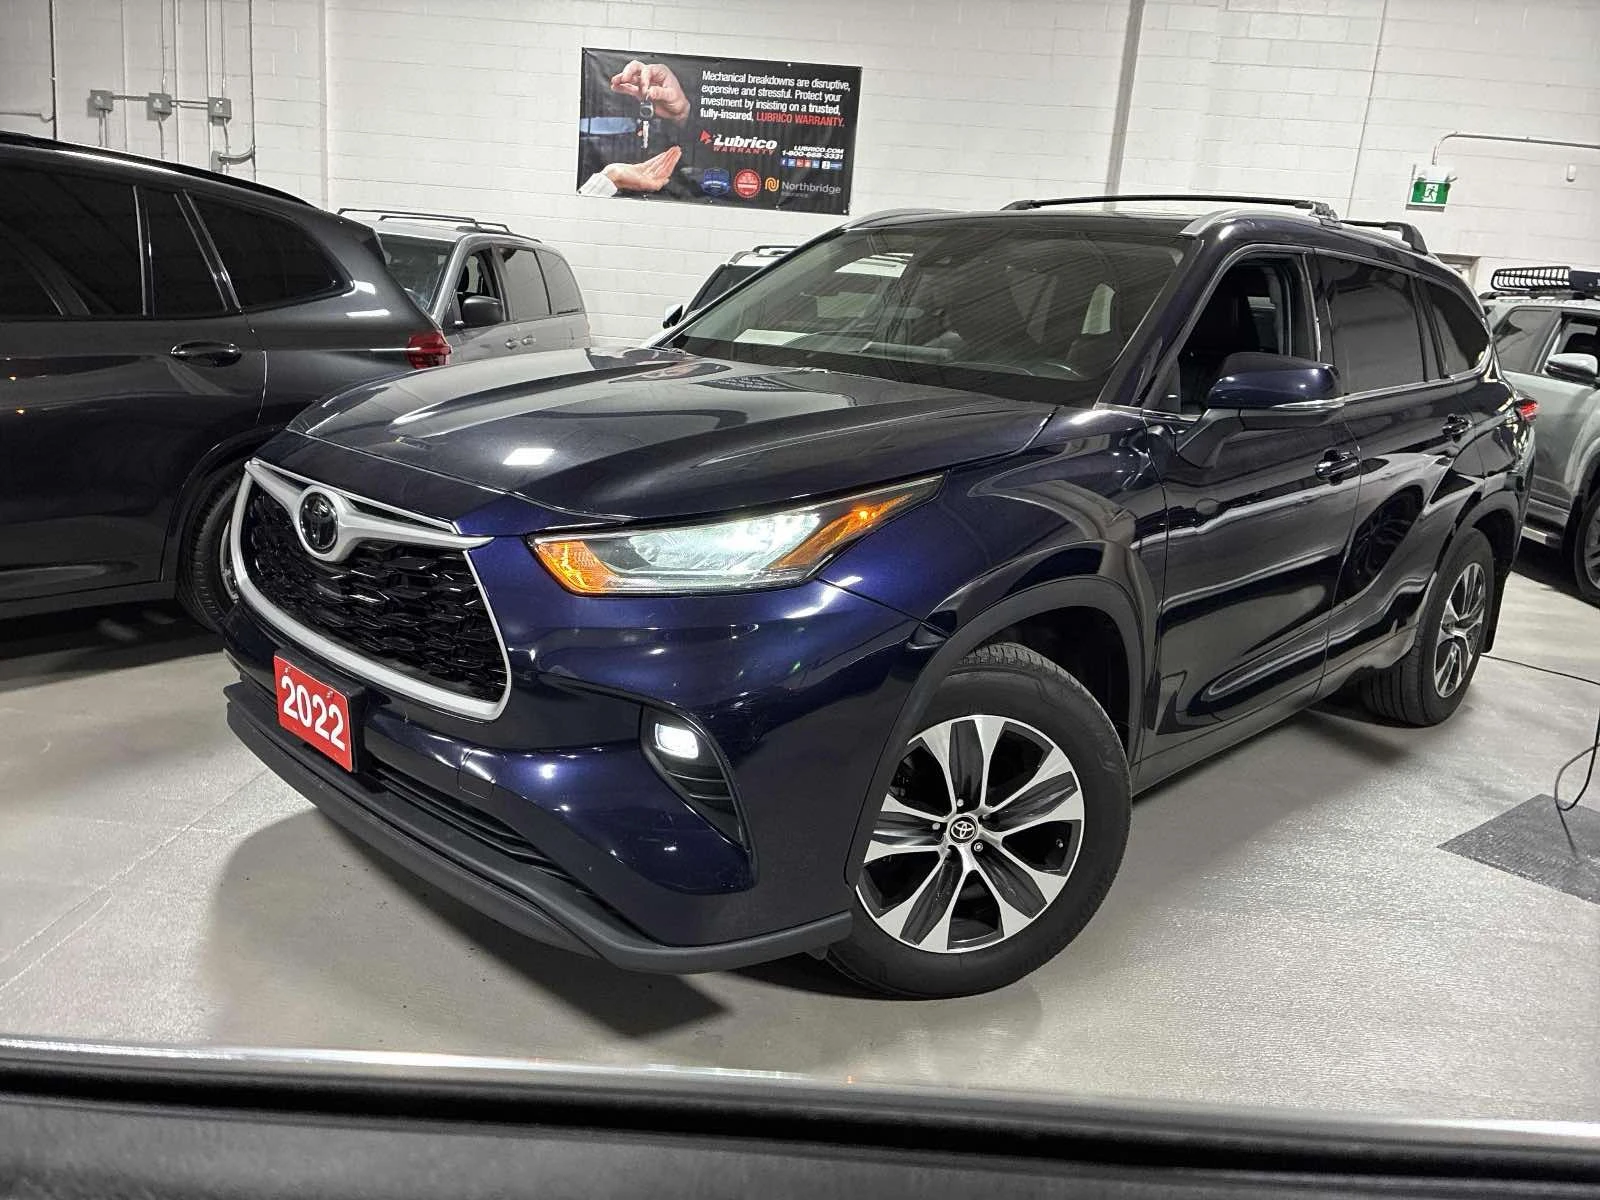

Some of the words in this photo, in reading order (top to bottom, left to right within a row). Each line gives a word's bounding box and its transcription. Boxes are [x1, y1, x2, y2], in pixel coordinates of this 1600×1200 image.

[702, 70, 746, 83] Mechanical
[747, 74, 795, 86] breakdowns
[797, 78, 810, 87] are
[811, 78, 850, 92] disruptive,
[701, 84, 740, 95] expensive
[741, 87, 756, 96] and
[758, 87, 792, 98] stressful.
[795, 90, 822, 100] Protect
[824, 93, 842, 103] your
[700, 96, 742, 108] investment
[744, 98, 754, 110] by
[756, 100, 788, 112] insisting
[788, 103, 800, 112] on
[801, 104, 806, 112] a
[756, 112, 792, 124] LUBRICO
[714, 134, 778, 150] Lubrico
[714, 145, 775, 154] WARRANTY
[782, 181, 840, 194] Northbridge
[281, 675, 346, 752] 2022
